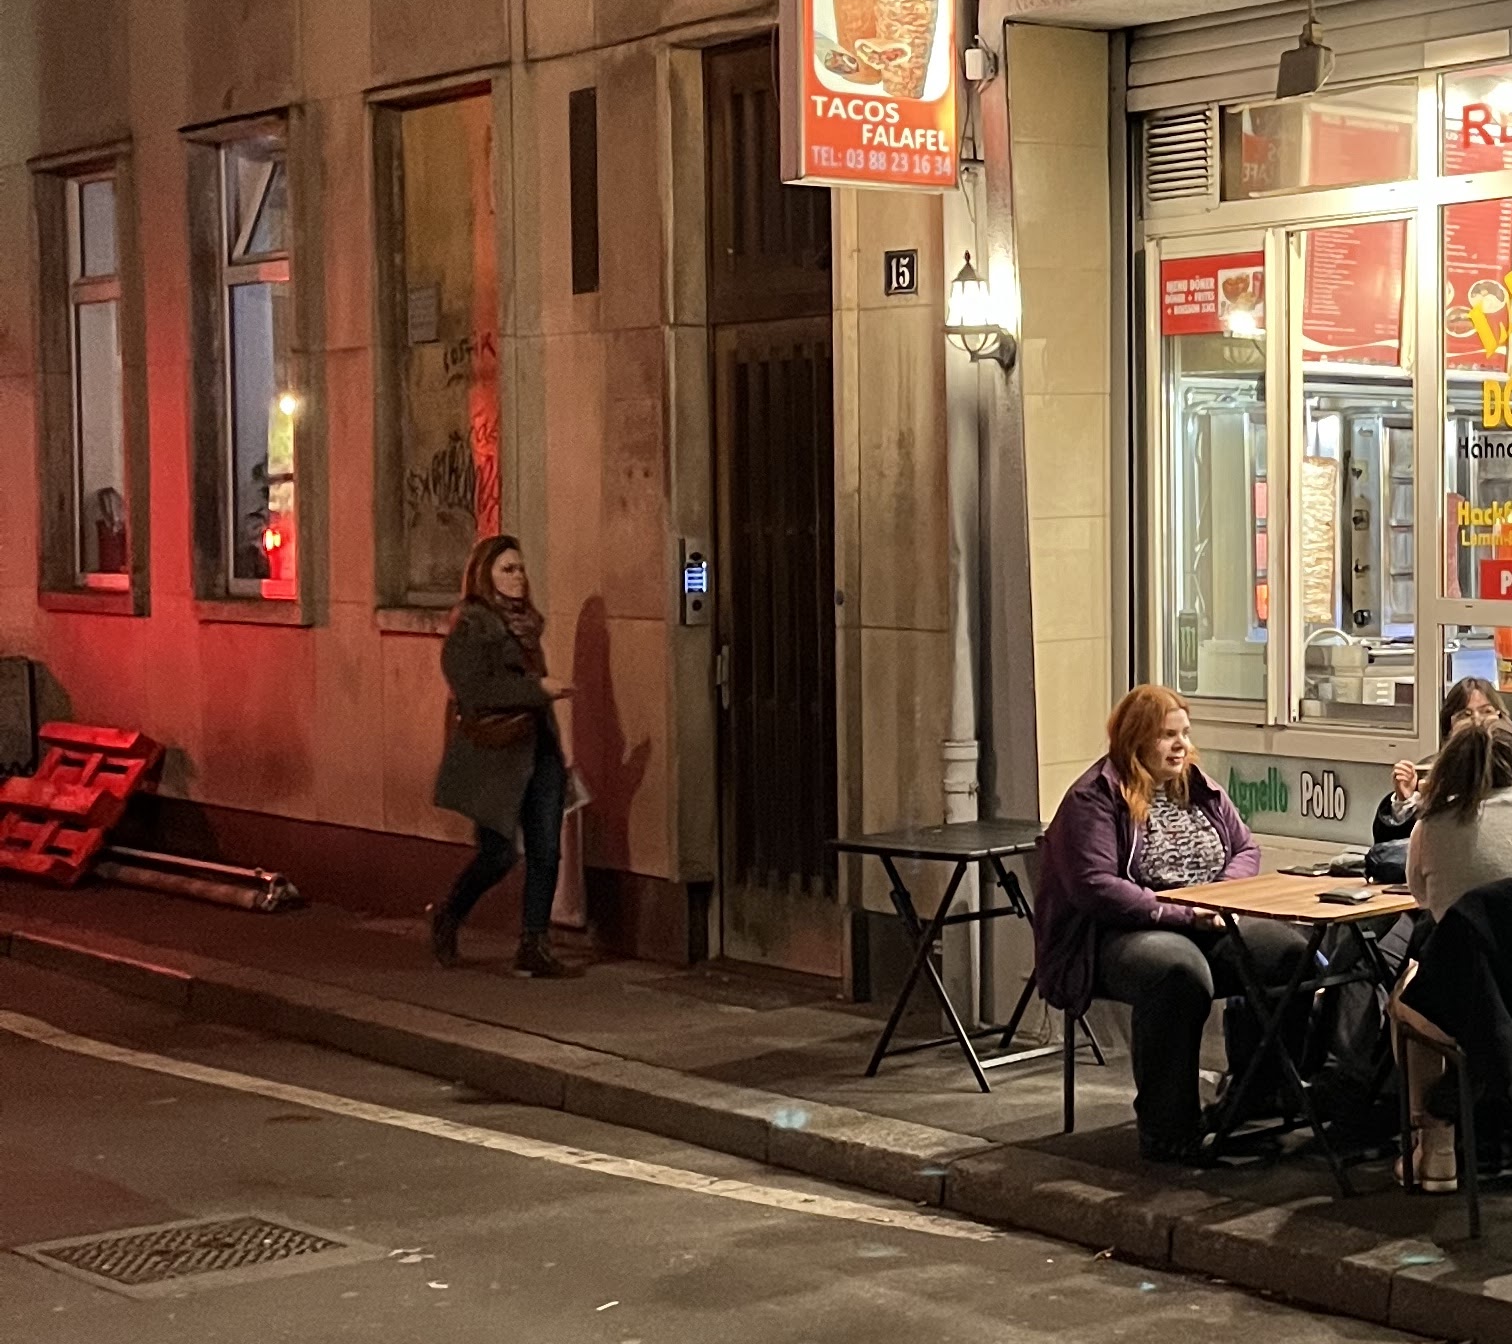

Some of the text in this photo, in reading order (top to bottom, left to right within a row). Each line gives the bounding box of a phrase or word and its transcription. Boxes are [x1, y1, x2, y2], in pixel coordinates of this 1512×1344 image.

[811, 95, 900, 124] TACOS
[862, 123, 950, 152] FALAFEL
[890, 257, 910, 289] 15
[1228, 766, 1347, 824] Agnello Pollo
